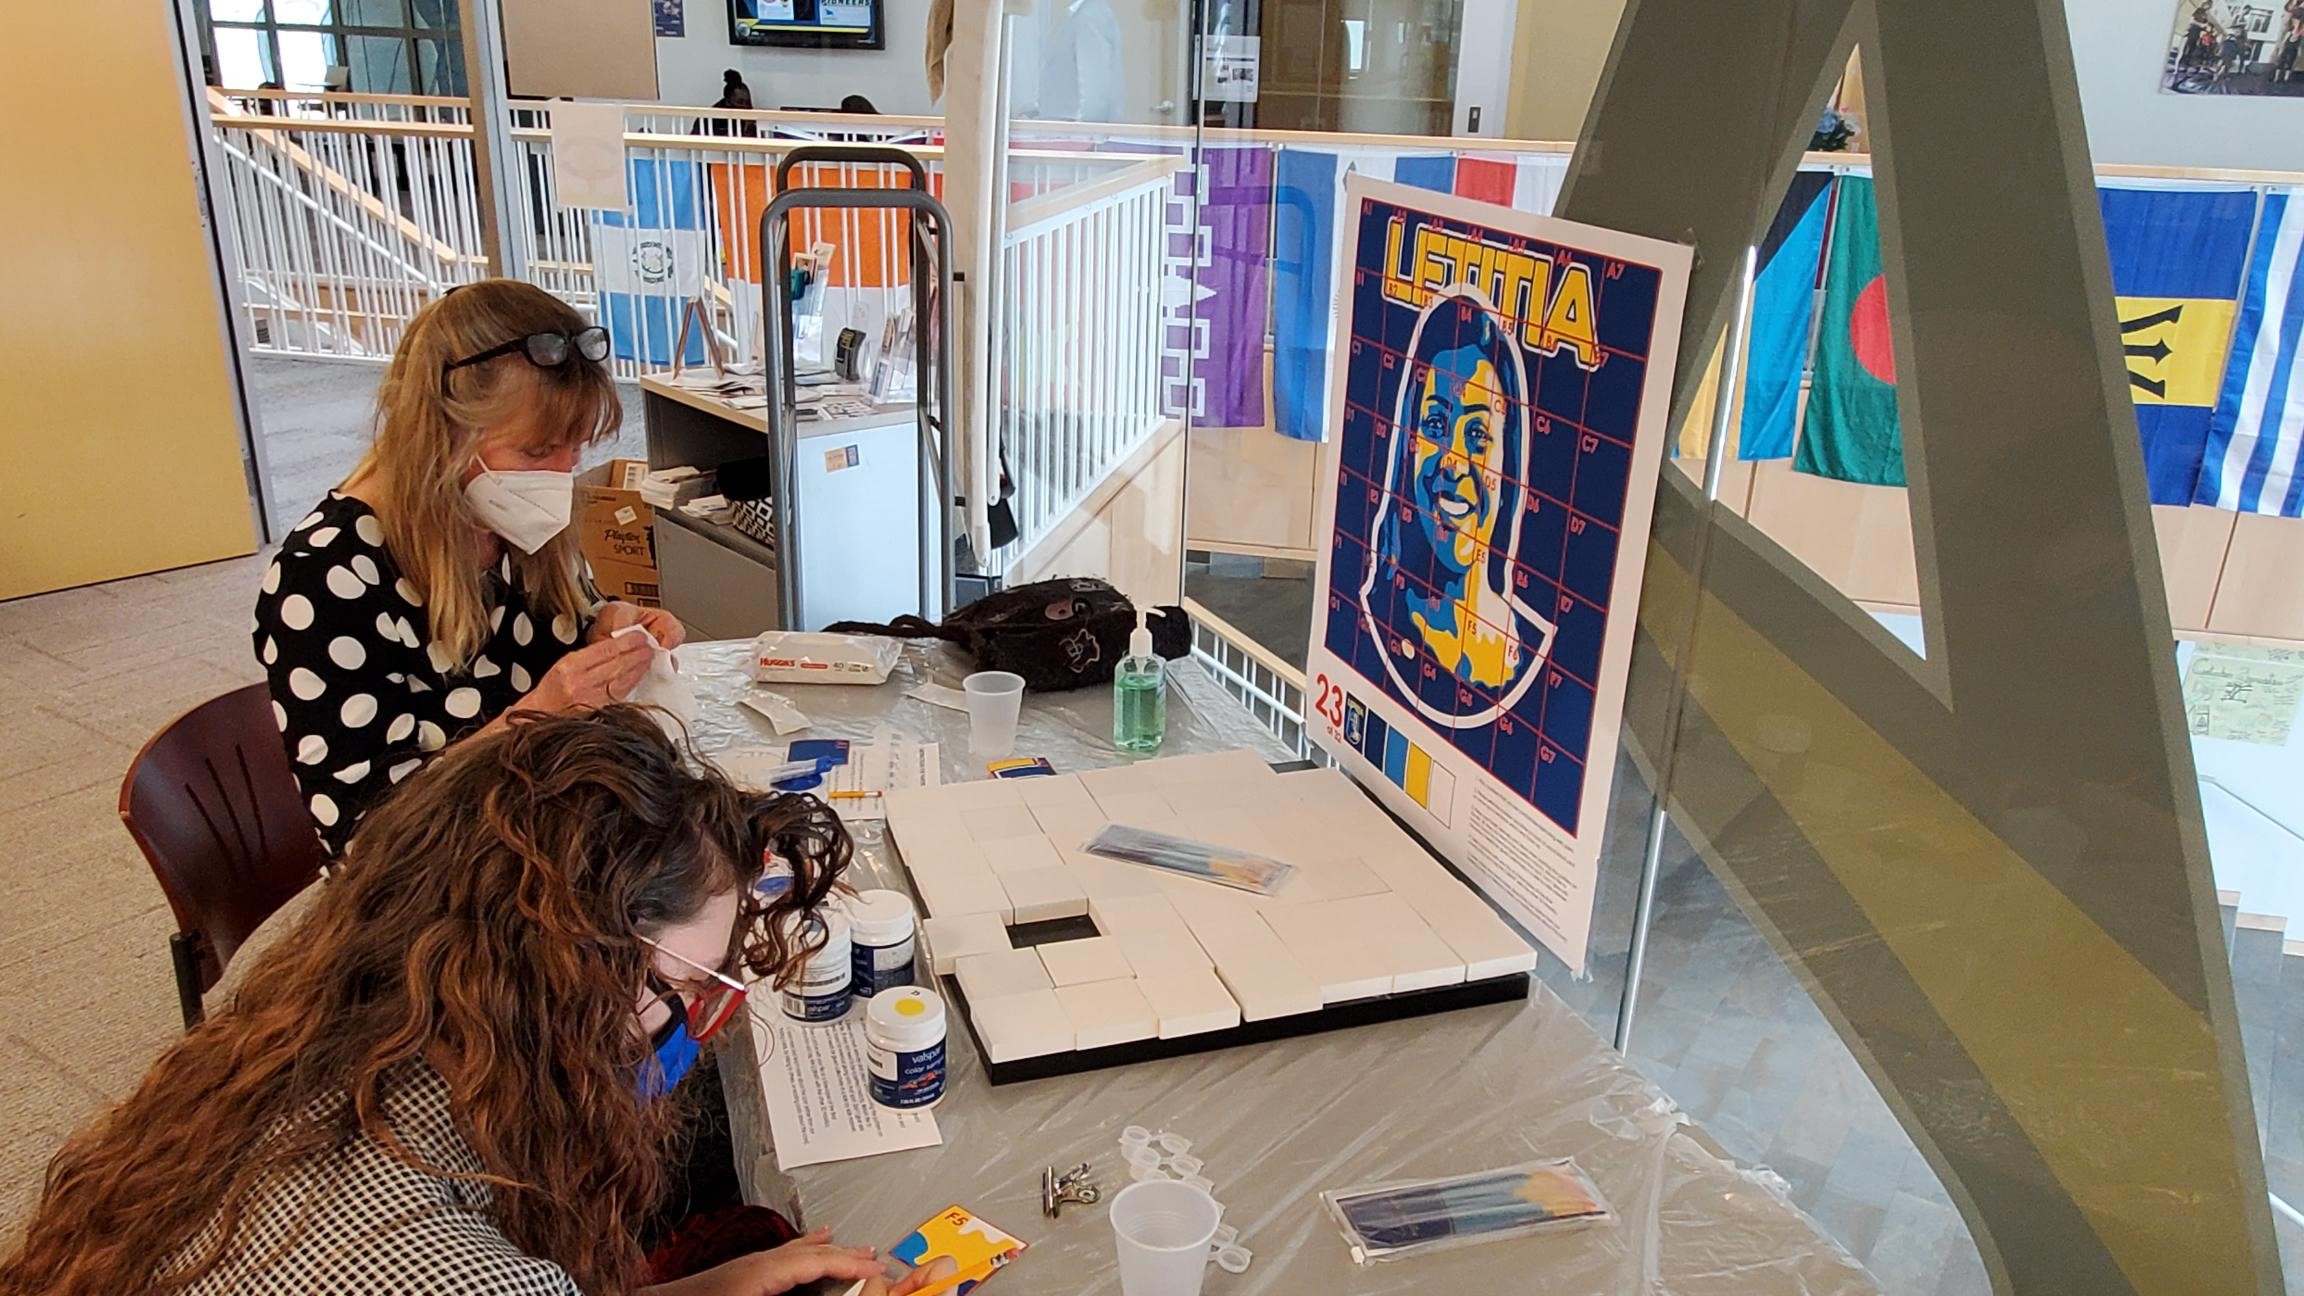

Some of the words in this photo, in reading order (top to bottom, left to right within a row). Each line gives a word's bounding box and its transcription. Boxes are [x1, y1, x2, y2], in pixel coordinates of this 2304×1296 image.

[1606, 262, 1625, 281] A7
[1382, 216, 1601, 373] LETITIA
[1383, 352, 1395, 370] C2
[1536, 415, 1551, 435] C6
[1581, 434, 1599, 454] C7
[1484, 475, 1497, 491] D5
[1570, 515, 1586, 536] D7
[604, 528, 641, 545] Playtex
[614, 544, 645, 557] SPORT
[1476, 548, 1486, 564] E5
[1467, 620, 1478, 636] F5
[1508, 645, 1518, 661] F6
[1423, 662, 1437, 681] G4
[1315, 673, 1343, 728] 23
[1499, 716, 1514, 736] G6
[1540, 744, 1557, 764] G7
[904, 1063, 926, 1077] color
[944, 1211, 969, 1227] F5
